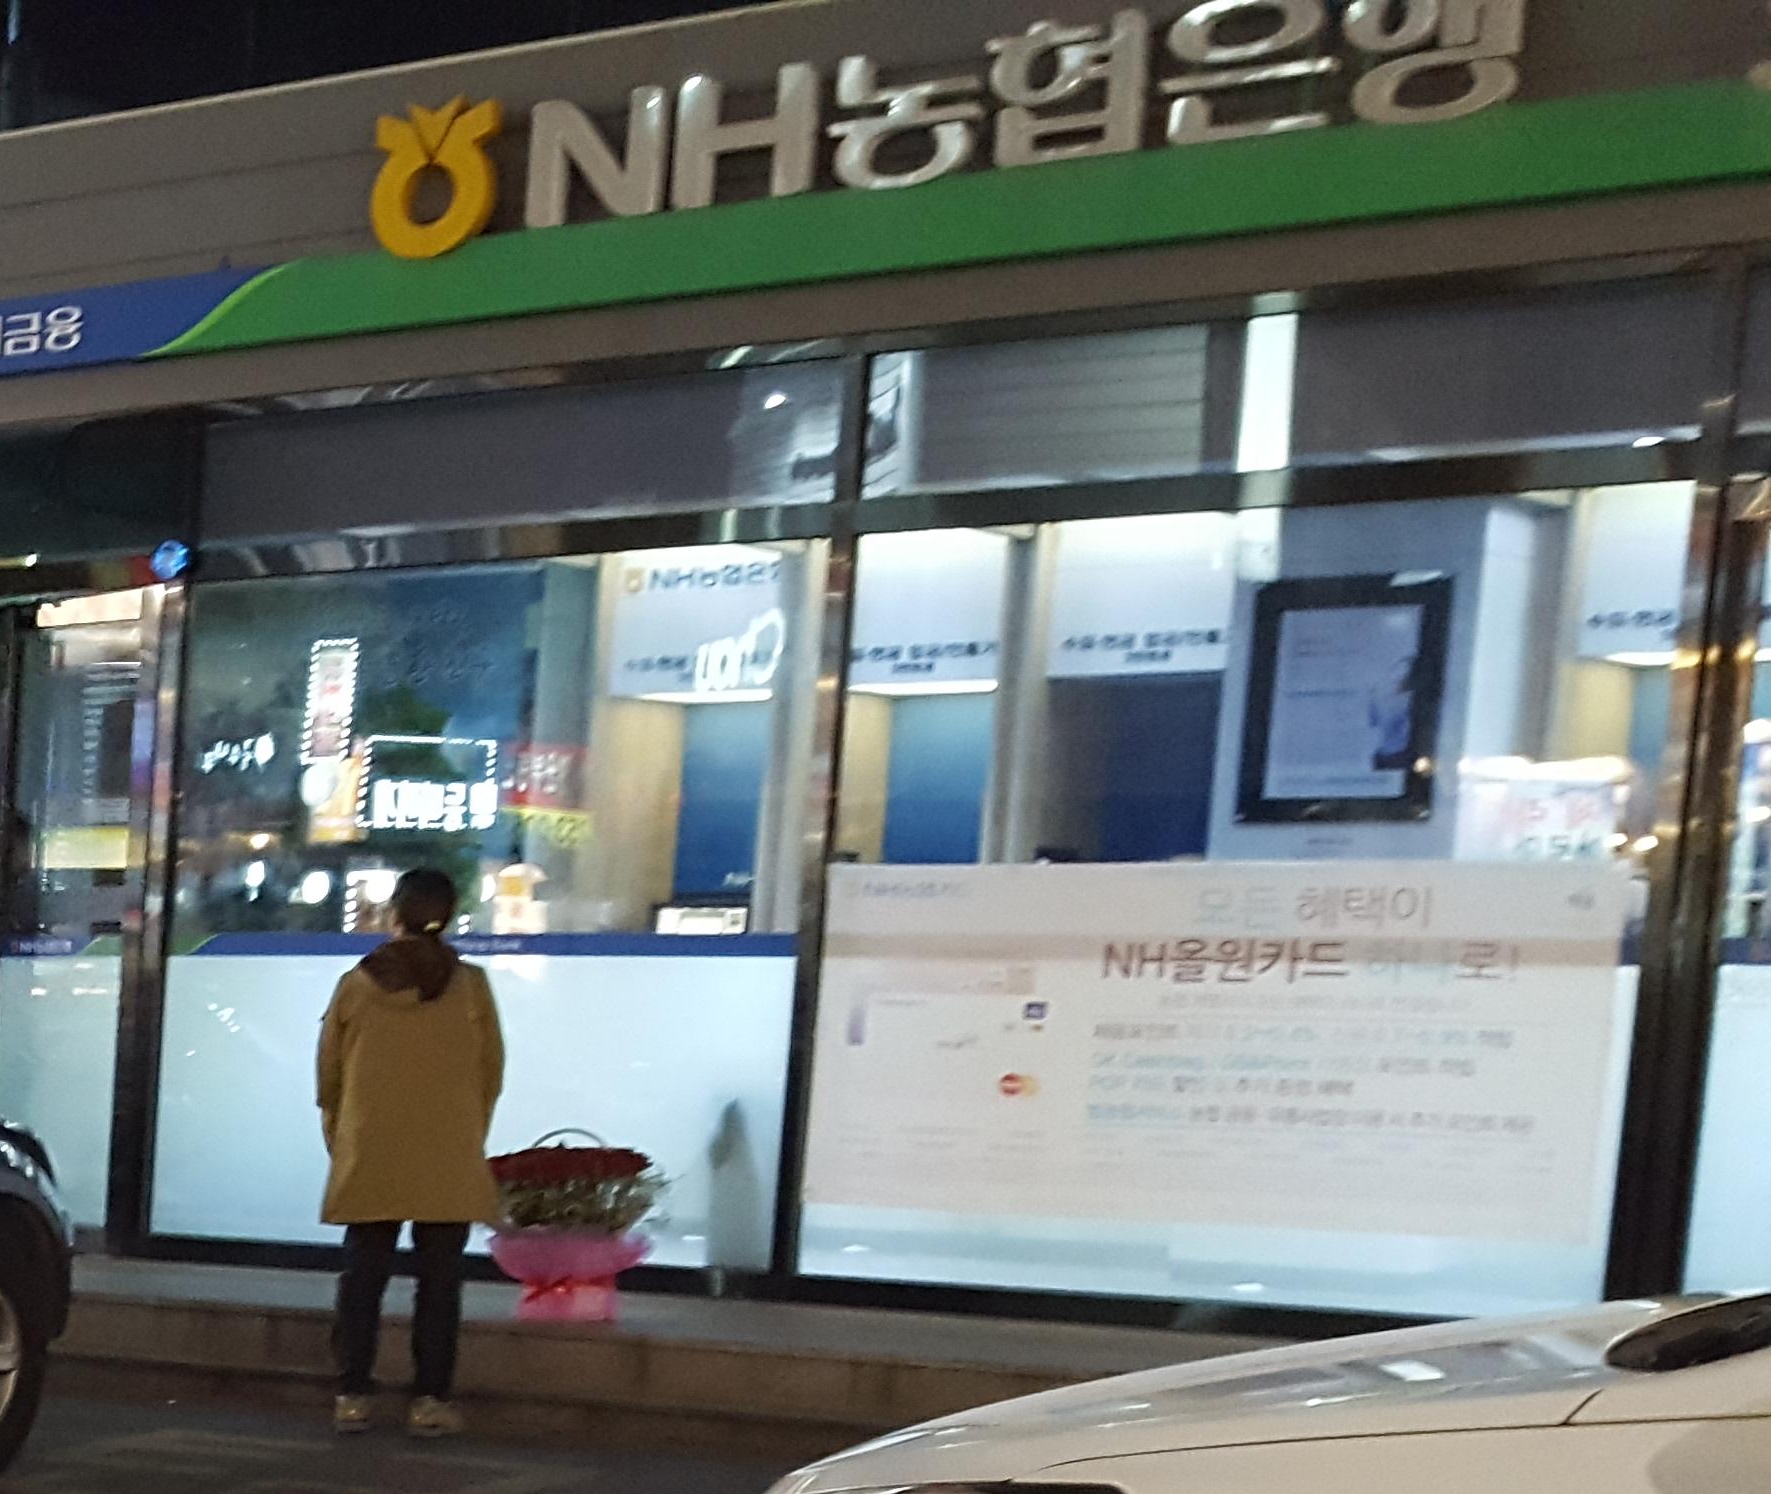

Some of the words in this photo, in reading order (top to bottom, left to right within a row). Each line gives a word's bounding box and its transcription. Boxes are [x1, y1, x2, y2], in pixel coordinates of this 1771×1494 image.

[524, 0, 1527, 229] NH농협은행
[1295, 886, 1435, 930] 혜택이
[1101, 936, 1350, 985] NH올원카드
